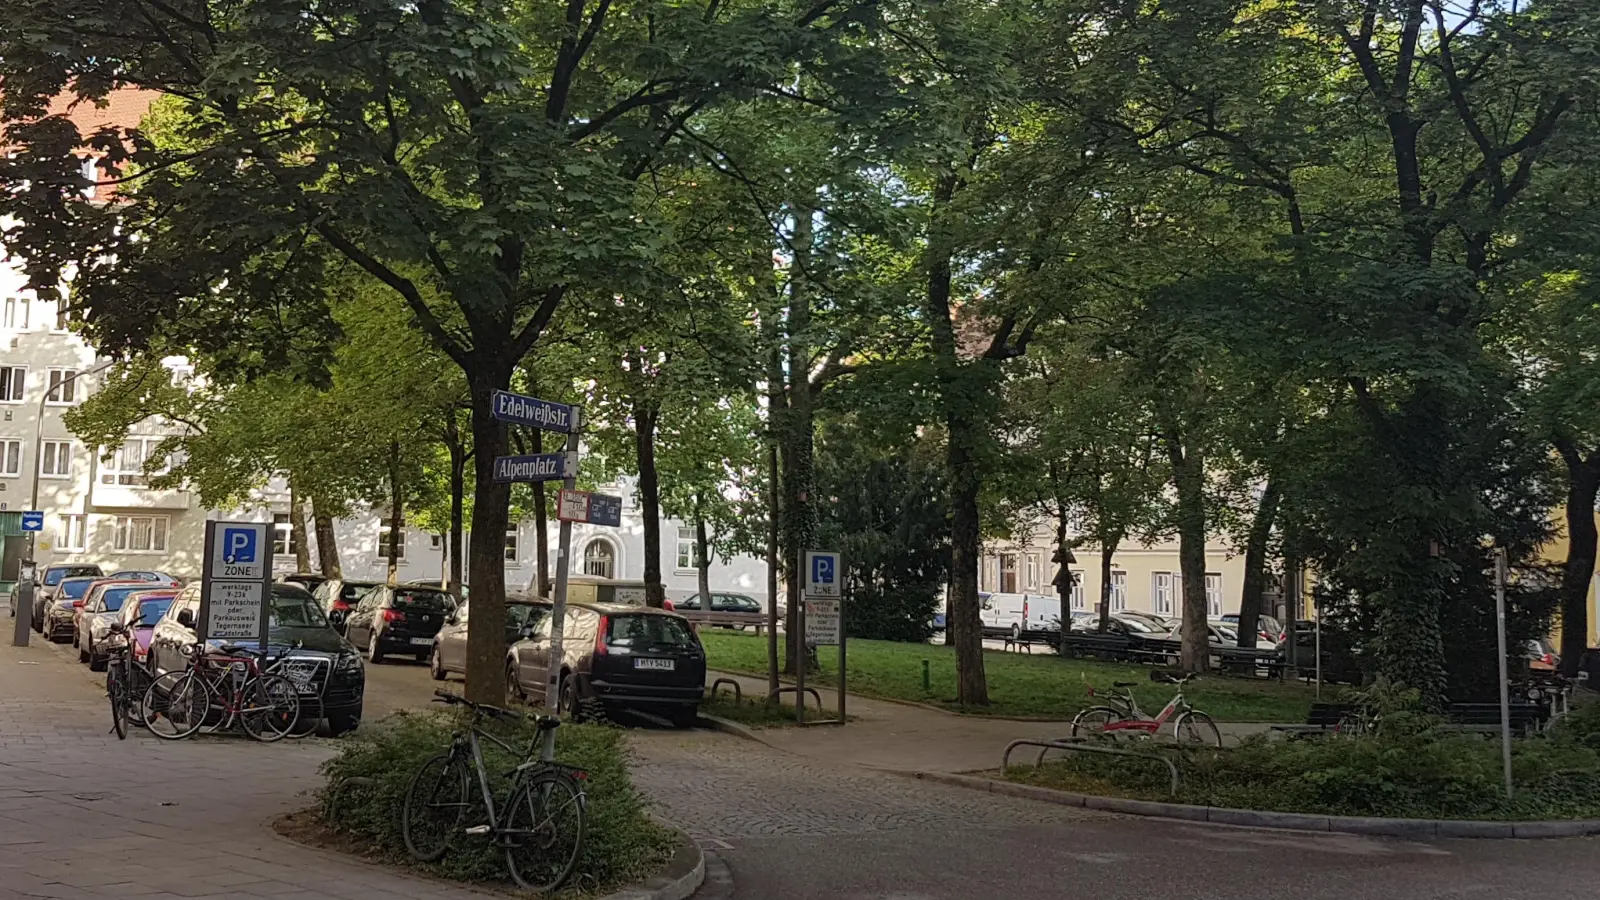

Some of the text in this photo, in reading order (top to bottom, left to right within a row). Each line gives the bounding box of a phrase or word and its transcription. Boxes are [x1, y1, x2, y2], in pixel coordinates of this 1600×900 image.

[499, 394, 568, 427] Edelweißstr.
[499, 457, 557, 480] Alpenplatz
[224, 566, 252, 576] ZONE
[222, 584, 252, 592] werktags
[215, 622, 253, 630] Tegernseer
